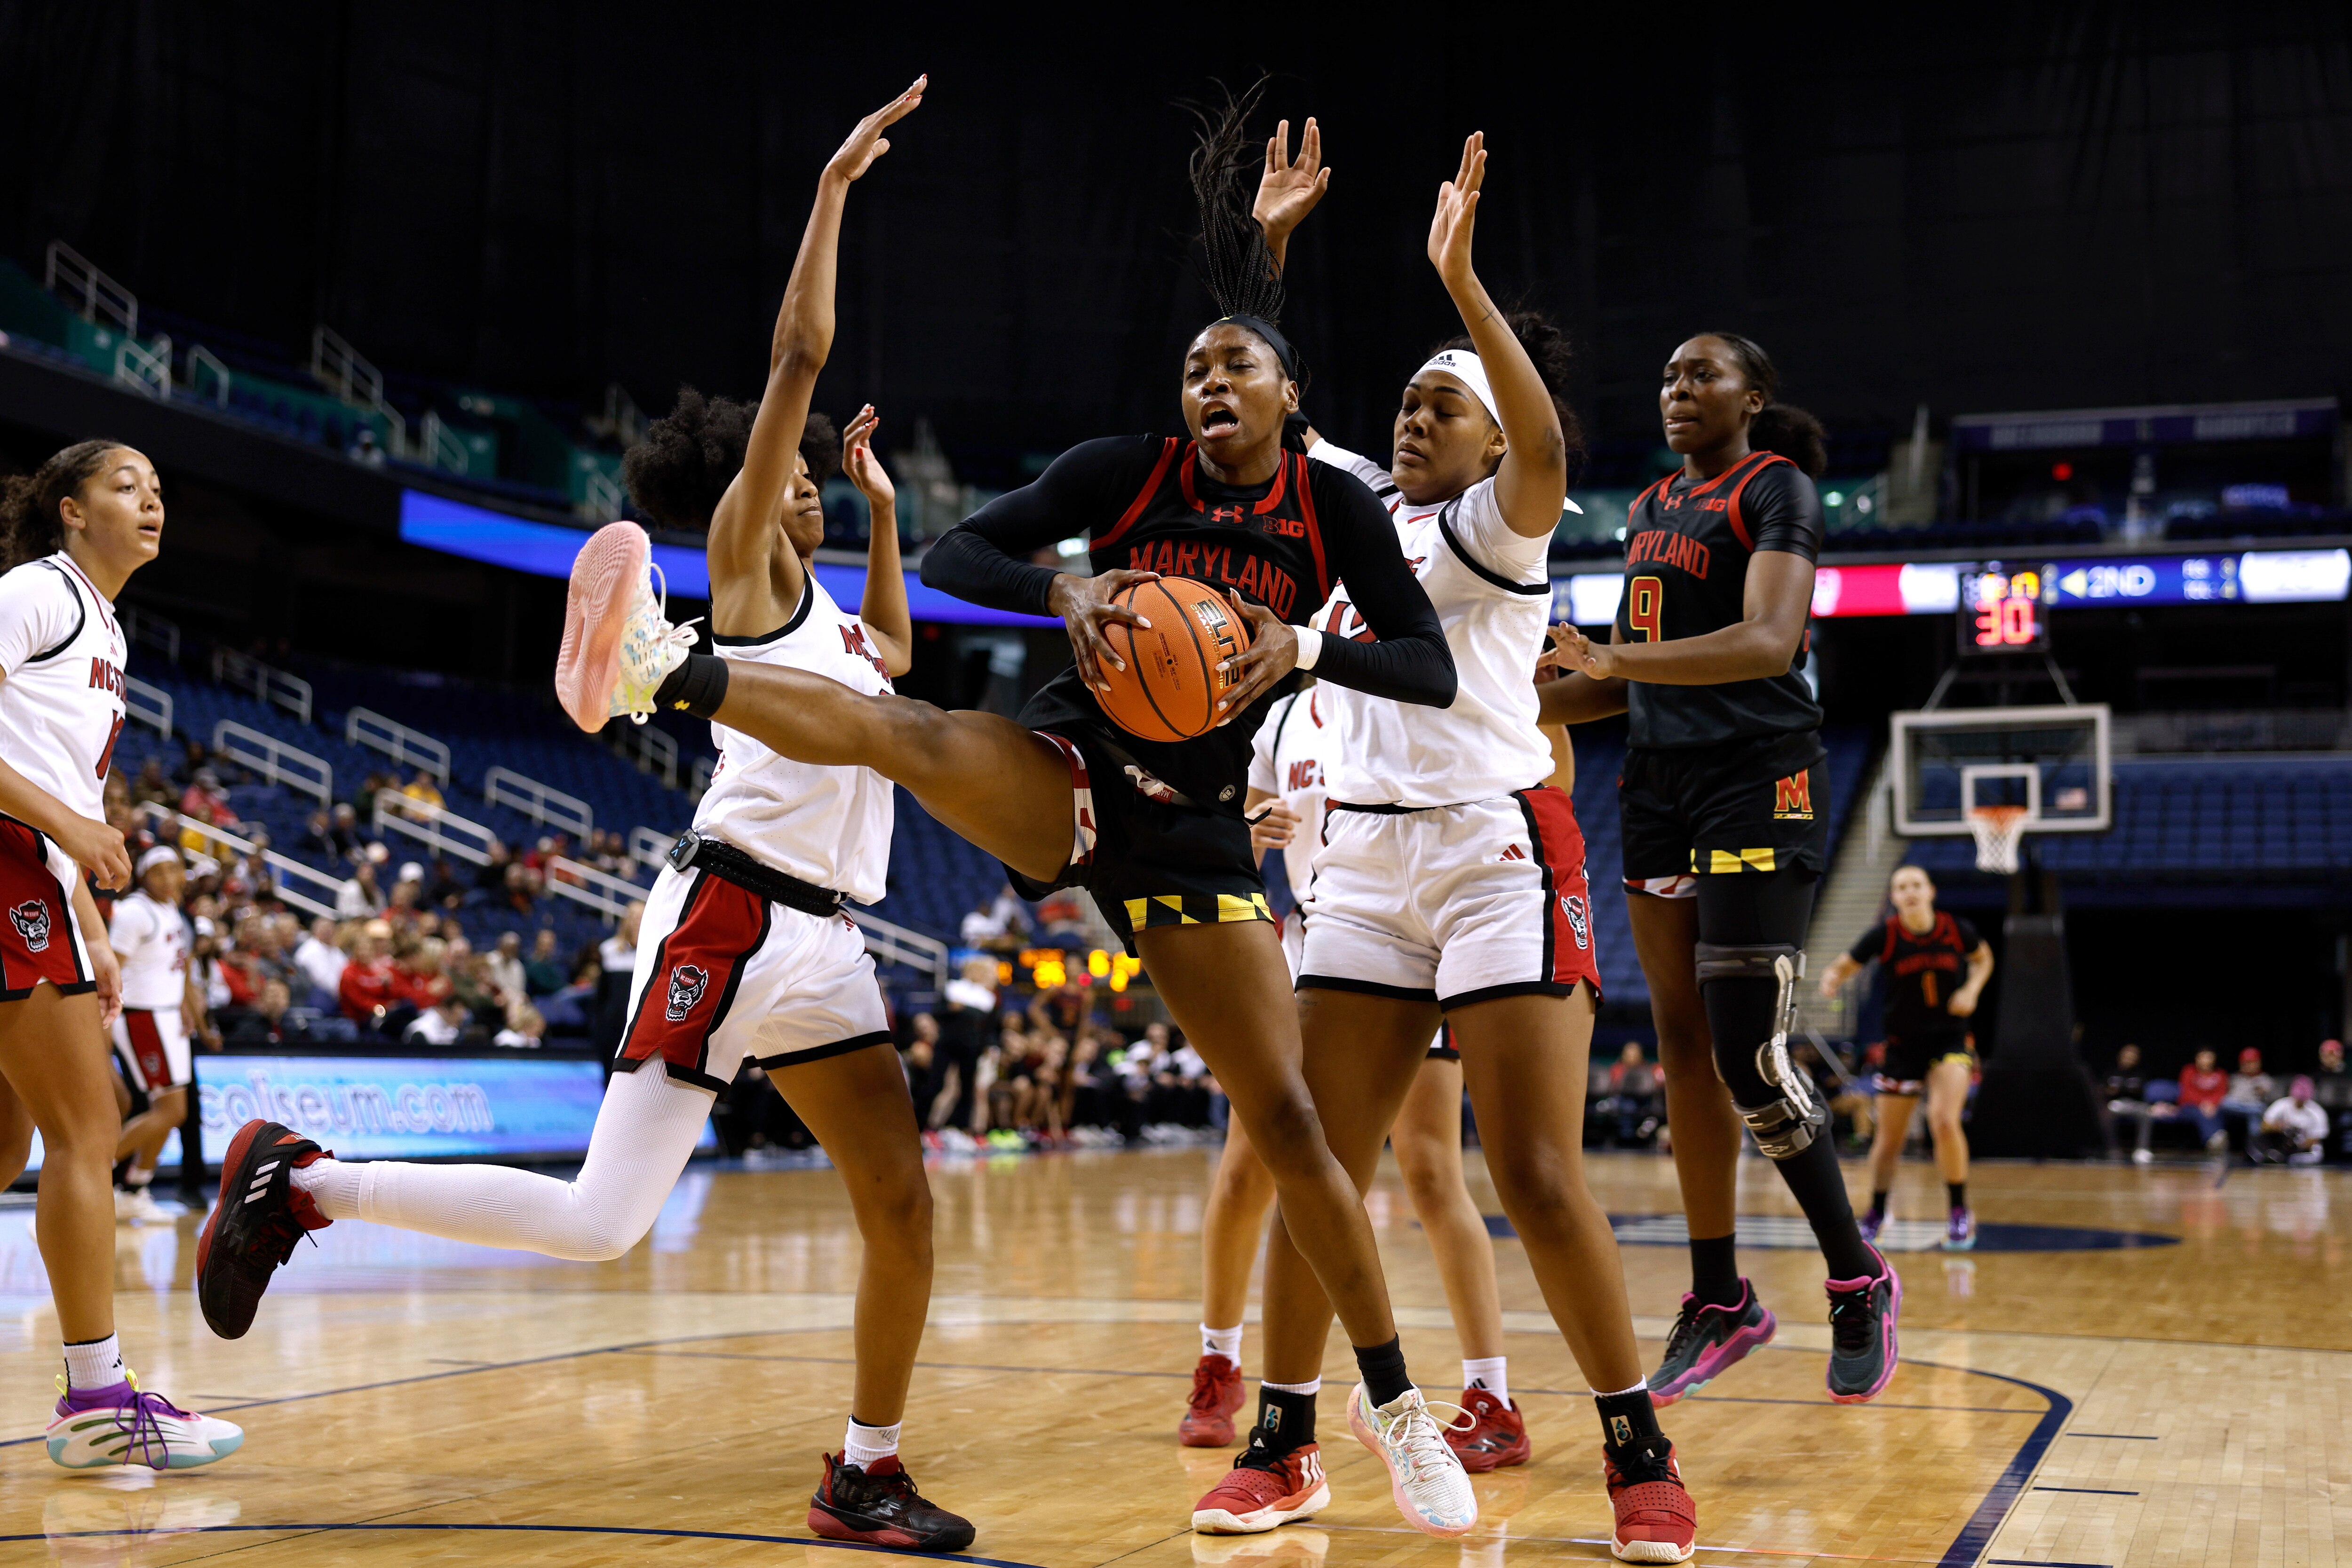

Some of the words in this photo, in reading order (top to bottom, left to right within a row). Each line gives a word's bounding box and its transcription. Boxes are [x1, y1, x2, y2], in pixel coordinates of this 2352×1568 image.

[1130, 539, 1296, 620] MARYLAND
[2087, 565, 2156, 598] 2ND
[1629, 576, 1662, 642] 9
[1975, 598, 2035, 646] 30
[1921, 970, 1939, 1008] 1
